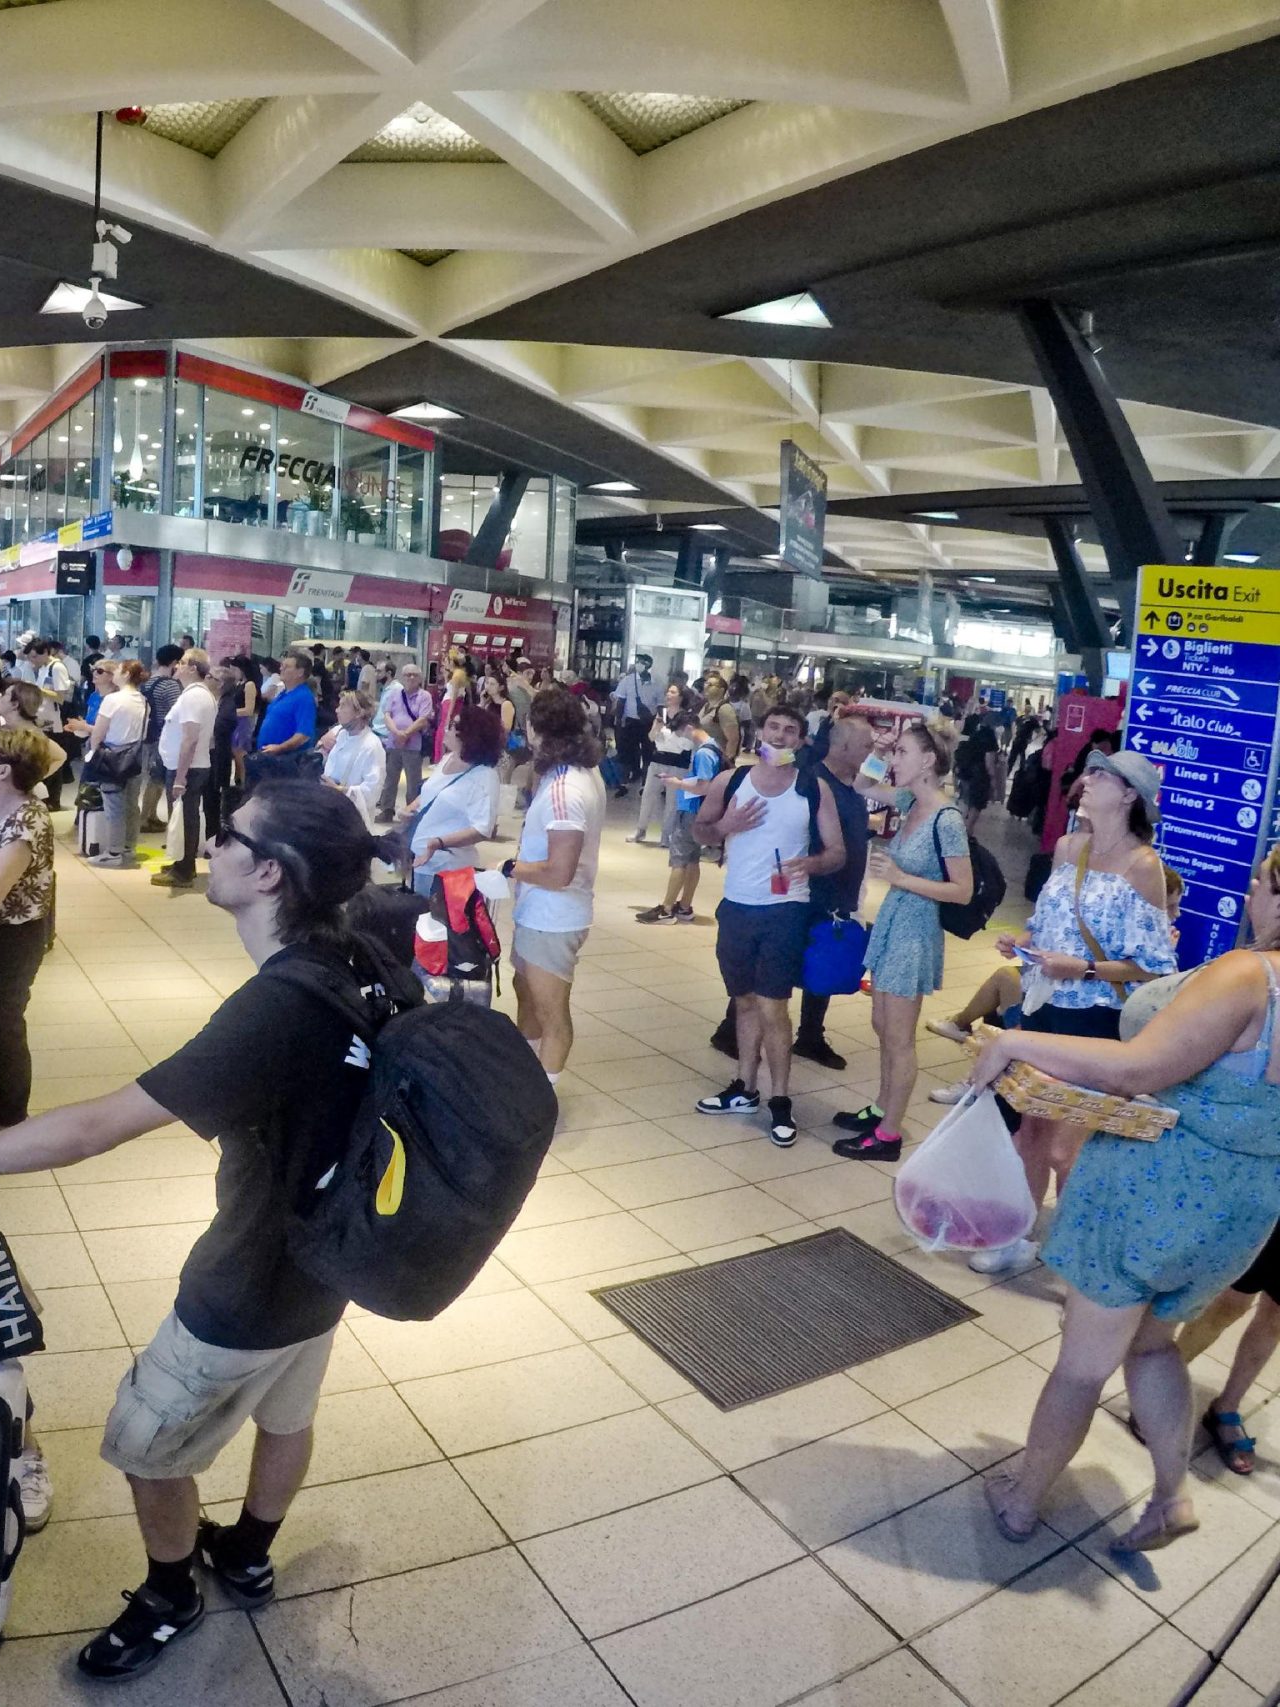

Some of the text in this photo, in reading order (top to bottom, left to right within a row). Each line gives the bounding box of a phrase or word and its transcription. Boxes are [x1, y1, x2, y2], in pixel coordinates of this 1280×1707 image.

[239, 446, 340, 490] FRECCIA
[1158, 578, 1261, 602] Uscita Exit
[1204, 613, 1244, 623] Garibaldi
[1184, 640, 1233, 655] Biglietti
[1182, 661, 1203, 672] NTV
[1165, 685, 1221, 698] FRECCIA CLUB
[1207, 720, 1234, 734] Club
[1174, 766, 1219, 784] Linea 1
[1170, 793, 1215, 811] Linea 2
[1163, 822, 1238, 846] Circumvesuviana
